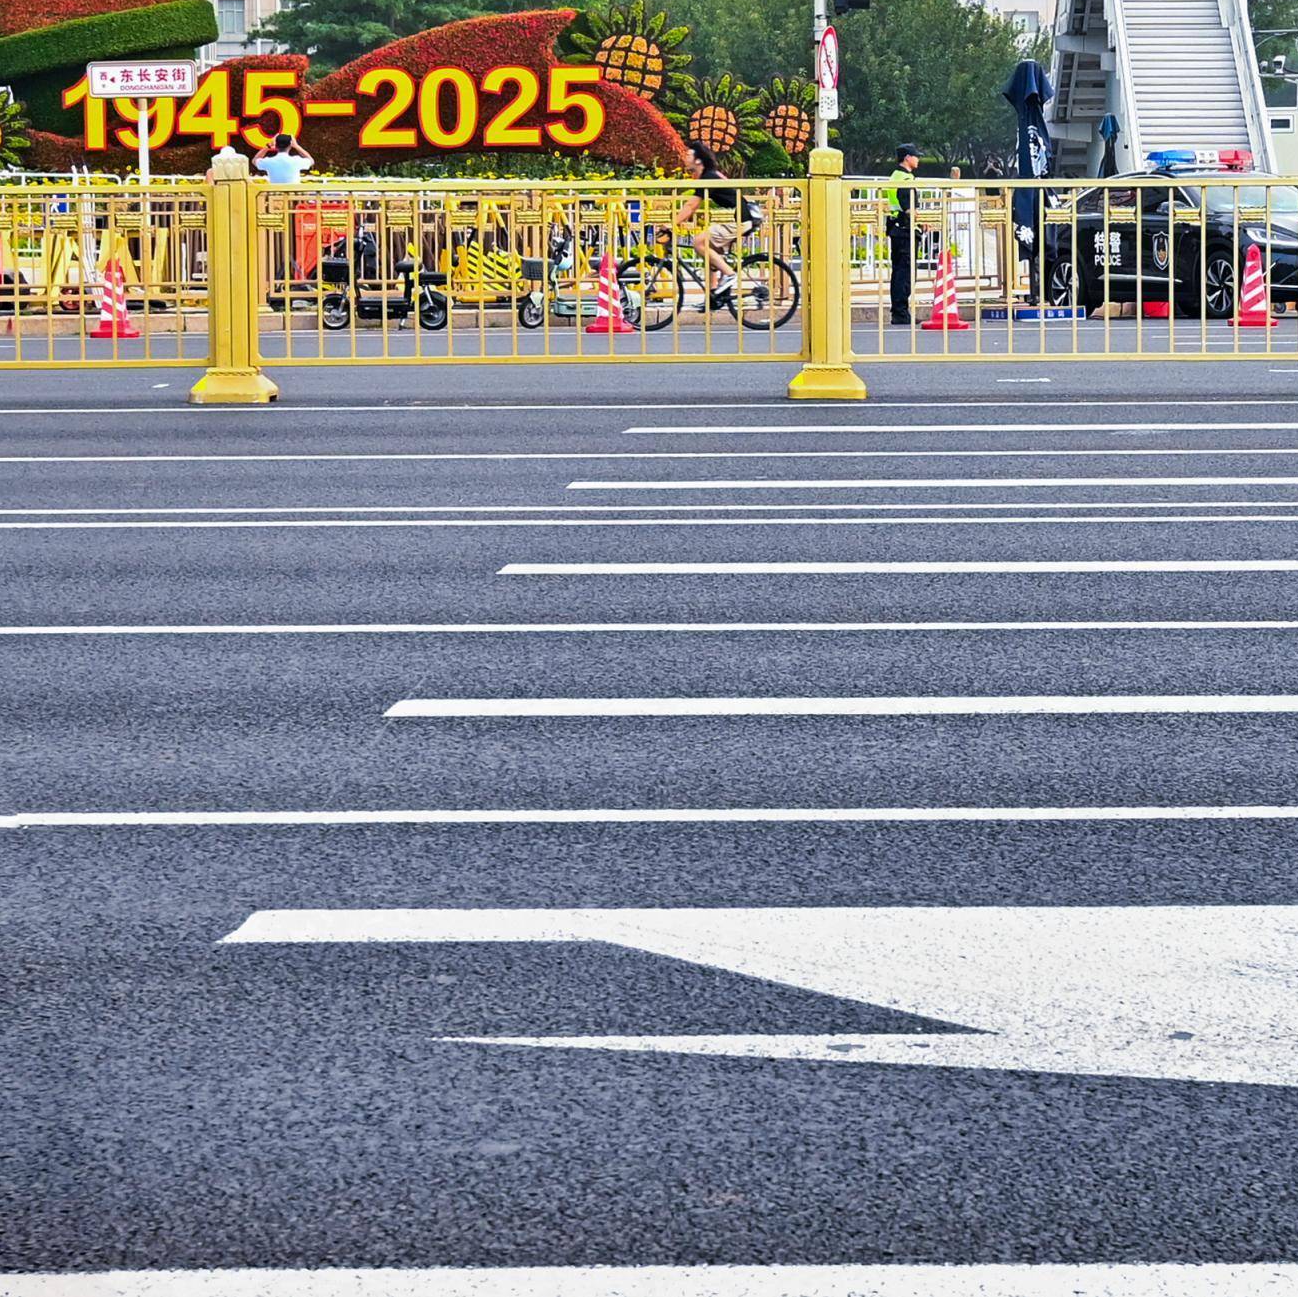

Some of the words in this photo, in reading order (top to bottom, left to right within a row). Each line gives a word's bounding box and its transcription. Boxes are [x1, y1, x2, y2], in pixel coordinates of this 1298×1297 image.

[119, 68, 187, 83] 东长安街
[63, 65, 605, 153] 1945-2025
[1094, 255, 1122, 266] POICE
